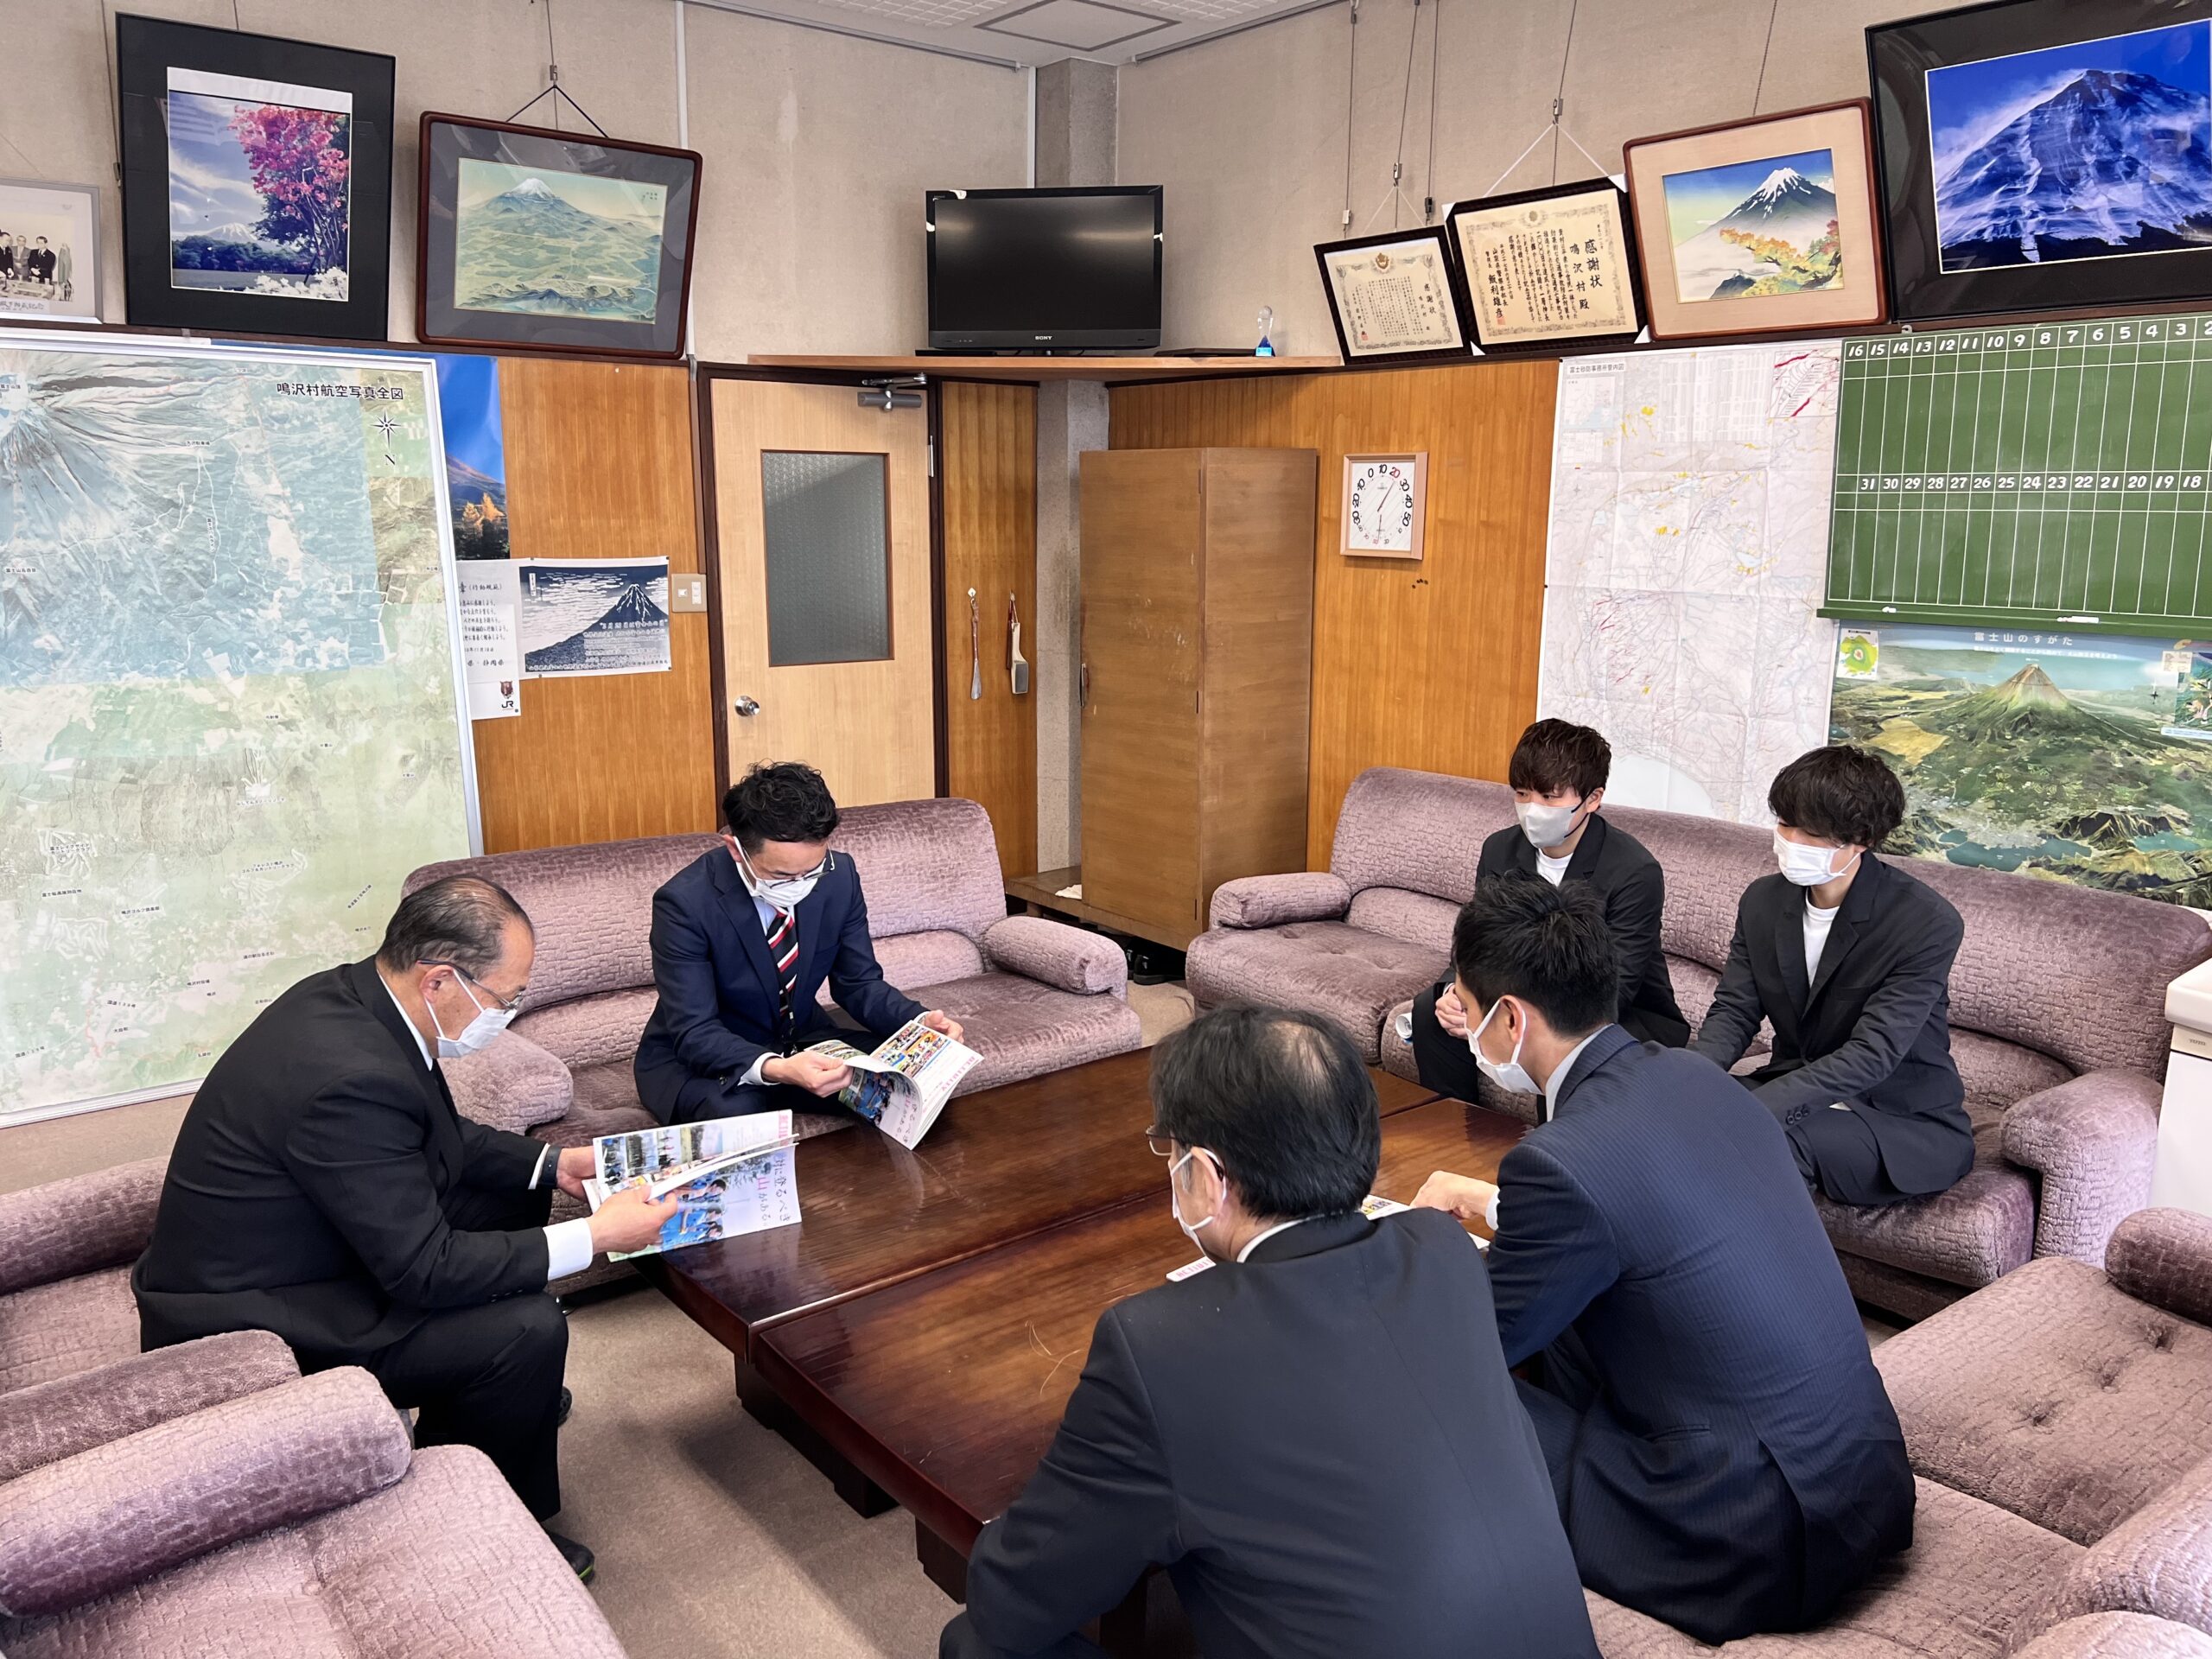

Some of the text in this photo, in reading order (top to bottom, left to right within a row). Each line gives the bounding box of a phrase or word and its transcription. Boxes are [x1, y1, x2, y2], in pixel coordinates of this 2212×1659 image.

[1585, 238, 1602, 288] 感謝状
[1570, 244, 1589, 309] 鳴沢村殿
[1424, 283, 1436, 315] 感謝状
[1849, 321, 2212, 357] 16 15 14 13 12 11 10 9 8 7 6 5 4 3 2
[1570, 364, 1624, 373] 富士砂防事務所管内図
[276, 383, 404, 400] 鳴沢村航空写真全図
[384, 454, 396, 465] N
[1368, 467, 1374, 478] 0
[1379, 464, 1388, 474] 10
[1389, 467, 1401, 479] 20
[1400, 479, 1409, 492] 30
[1860, 475, 2202, 490] 31 30 29 28 27 26 25 24 23 22 21 20 19 18
[1405, 494, 1413, 508] 40
[1402, 512, 1411, 526] 50
[1974, 632, 2073, 645] 富士山のすがた
